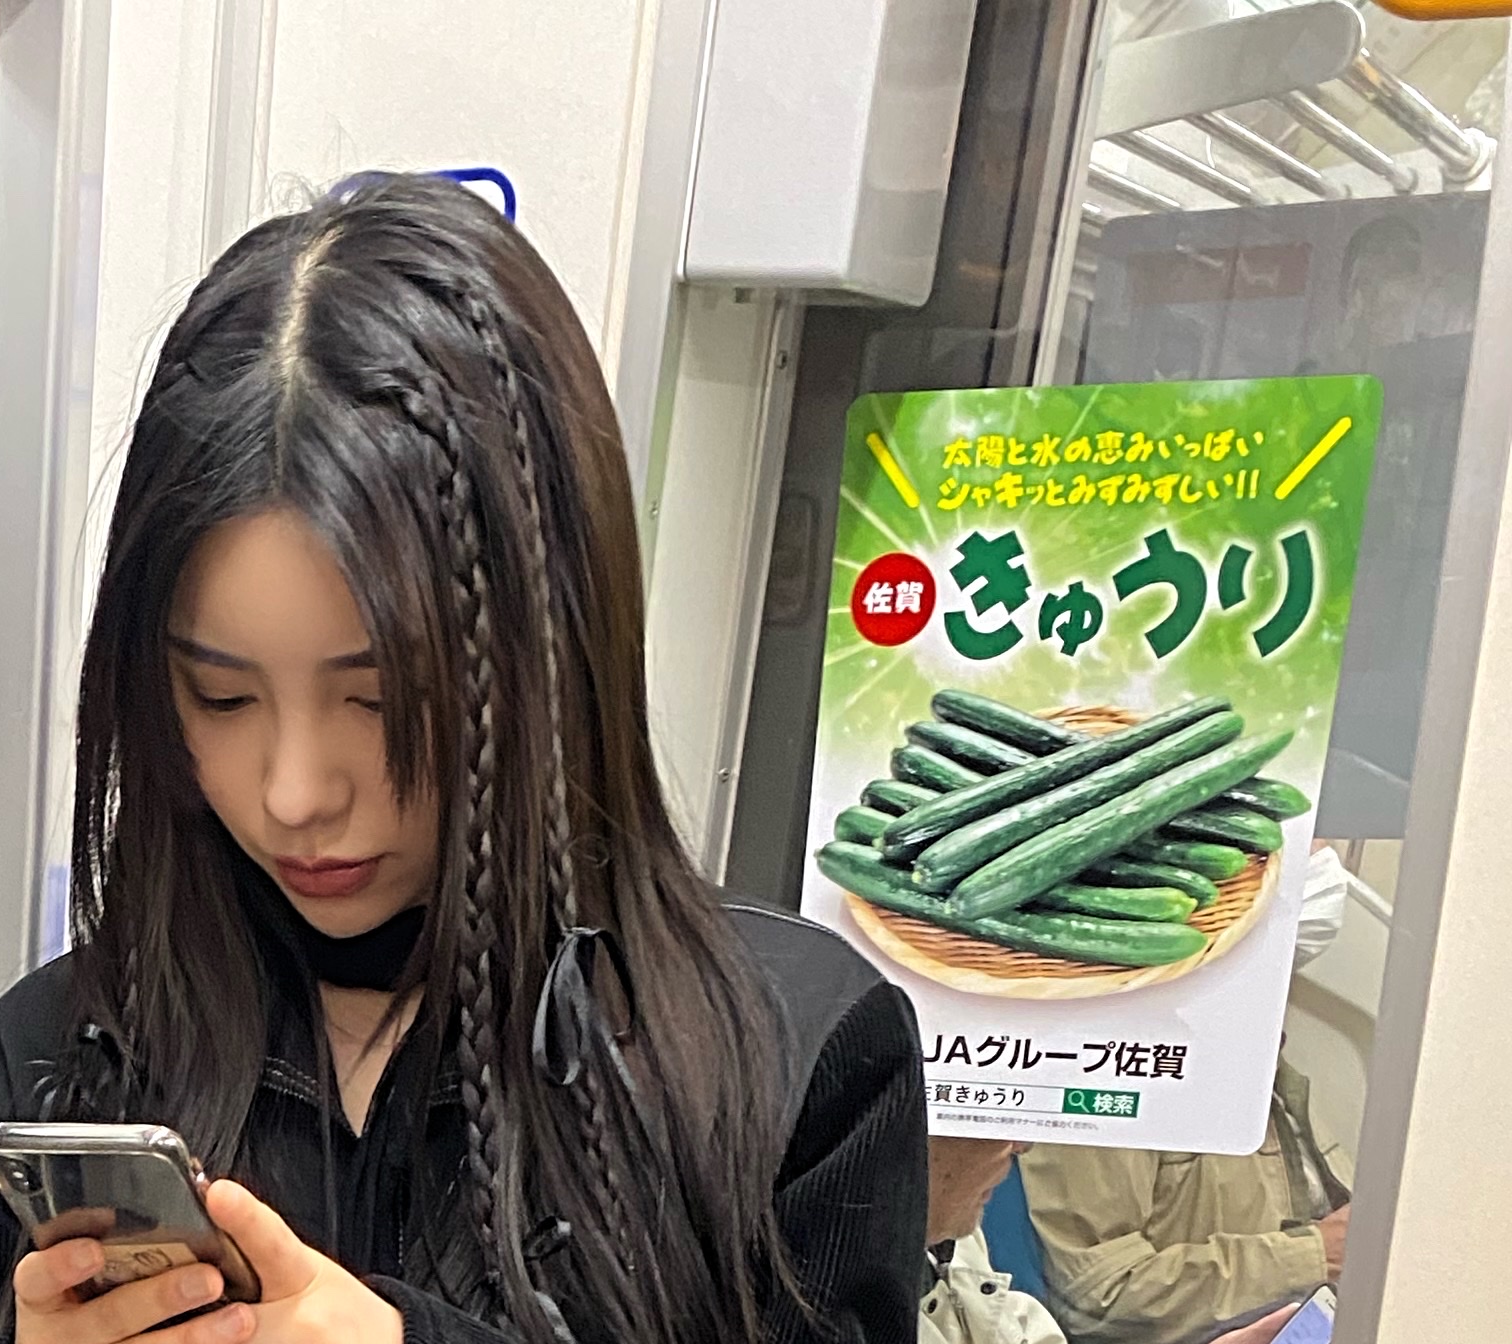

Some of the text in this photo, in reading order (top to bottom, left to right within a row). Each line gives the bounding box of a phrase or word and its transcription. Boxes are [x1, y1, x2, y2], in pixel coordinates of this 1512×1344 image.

[943, 430, 1264, 469] 太陽と水の恵みいっぱい
[862, 582, 922, 614] 佐賀
[943, 528, 1315, 661] きゅうり
[1092, 1092, 1135, 1115] 検索
